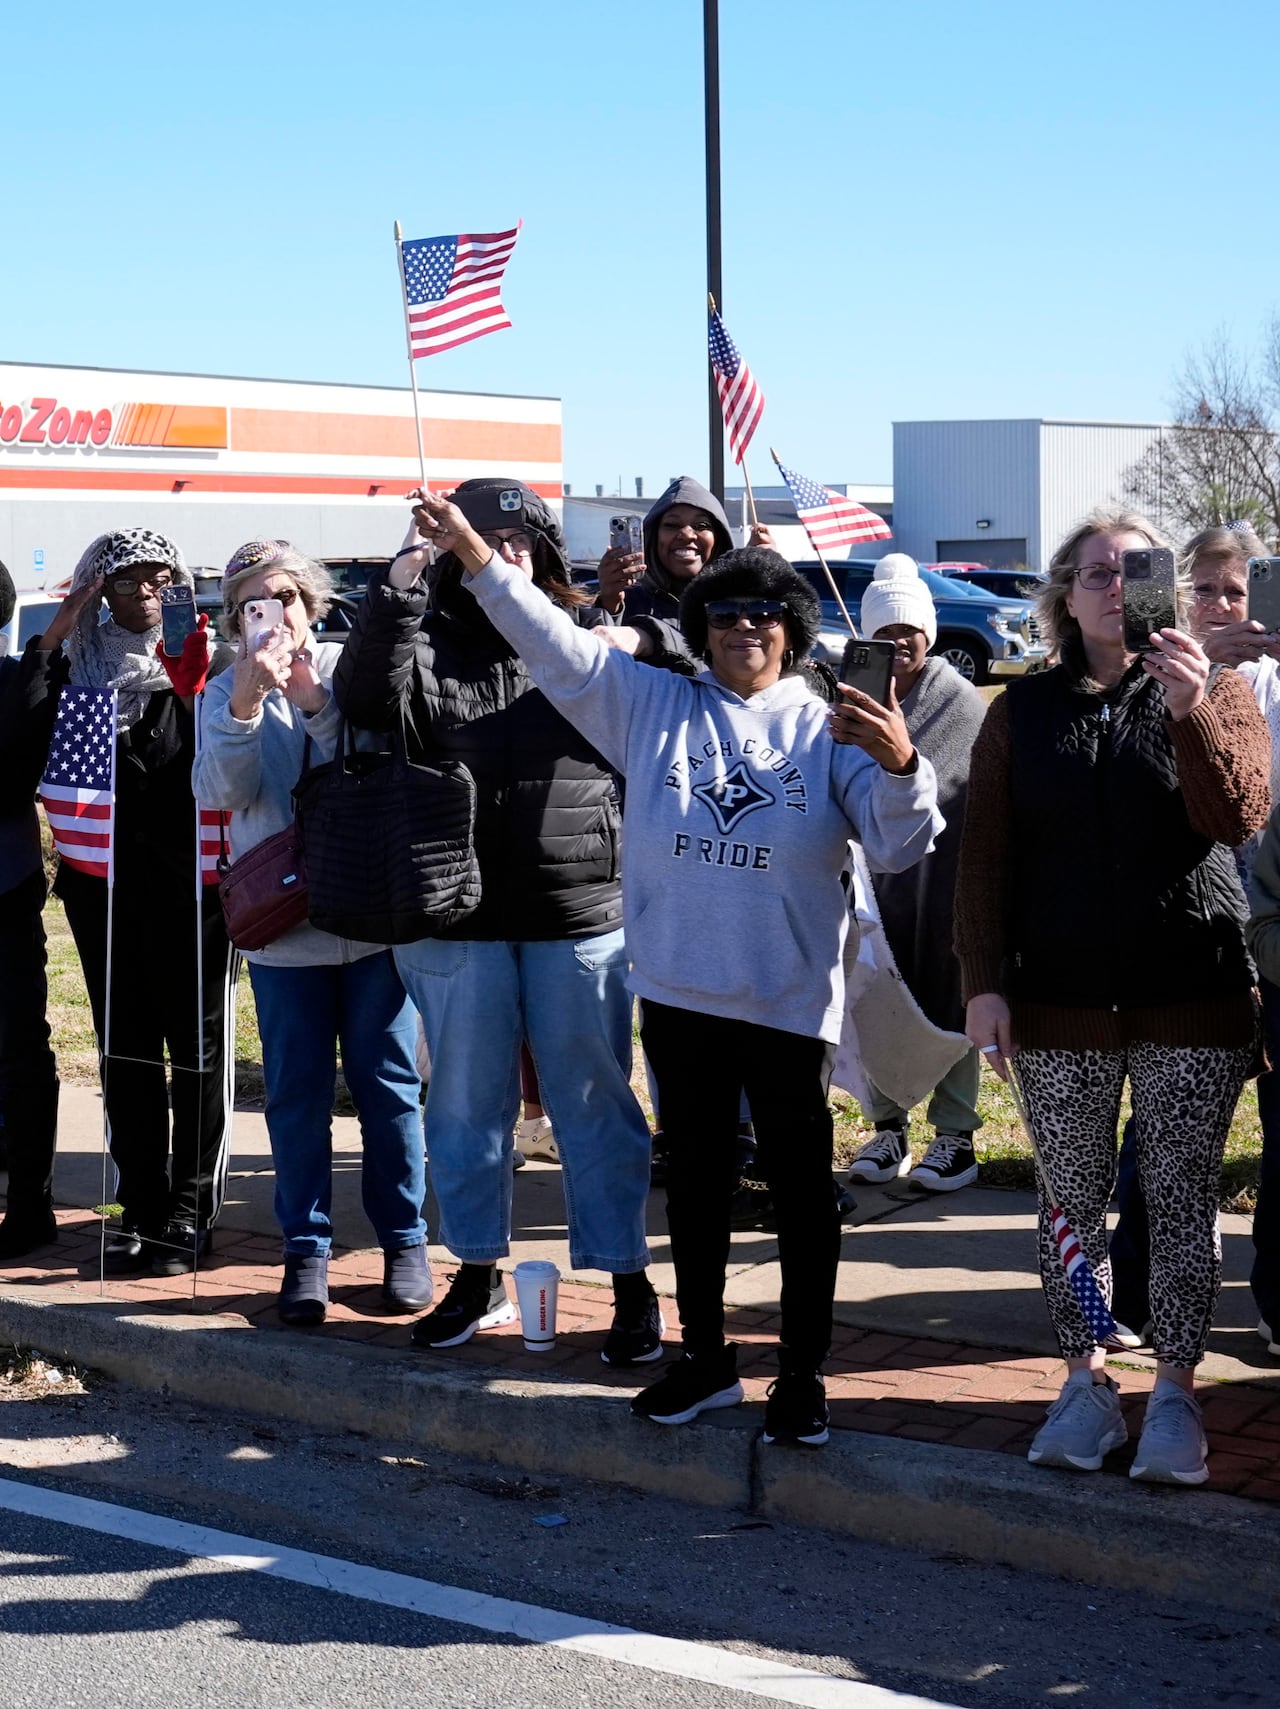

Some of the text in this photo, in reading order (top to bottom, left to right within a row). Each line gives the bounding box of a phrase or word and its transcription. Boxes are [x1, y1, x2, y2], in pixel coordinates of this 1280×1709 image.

[719, 783, 749, 808] P
[742, 739, 808, 815] COUNTY
[673, 833, 772, 870] PRIDE
